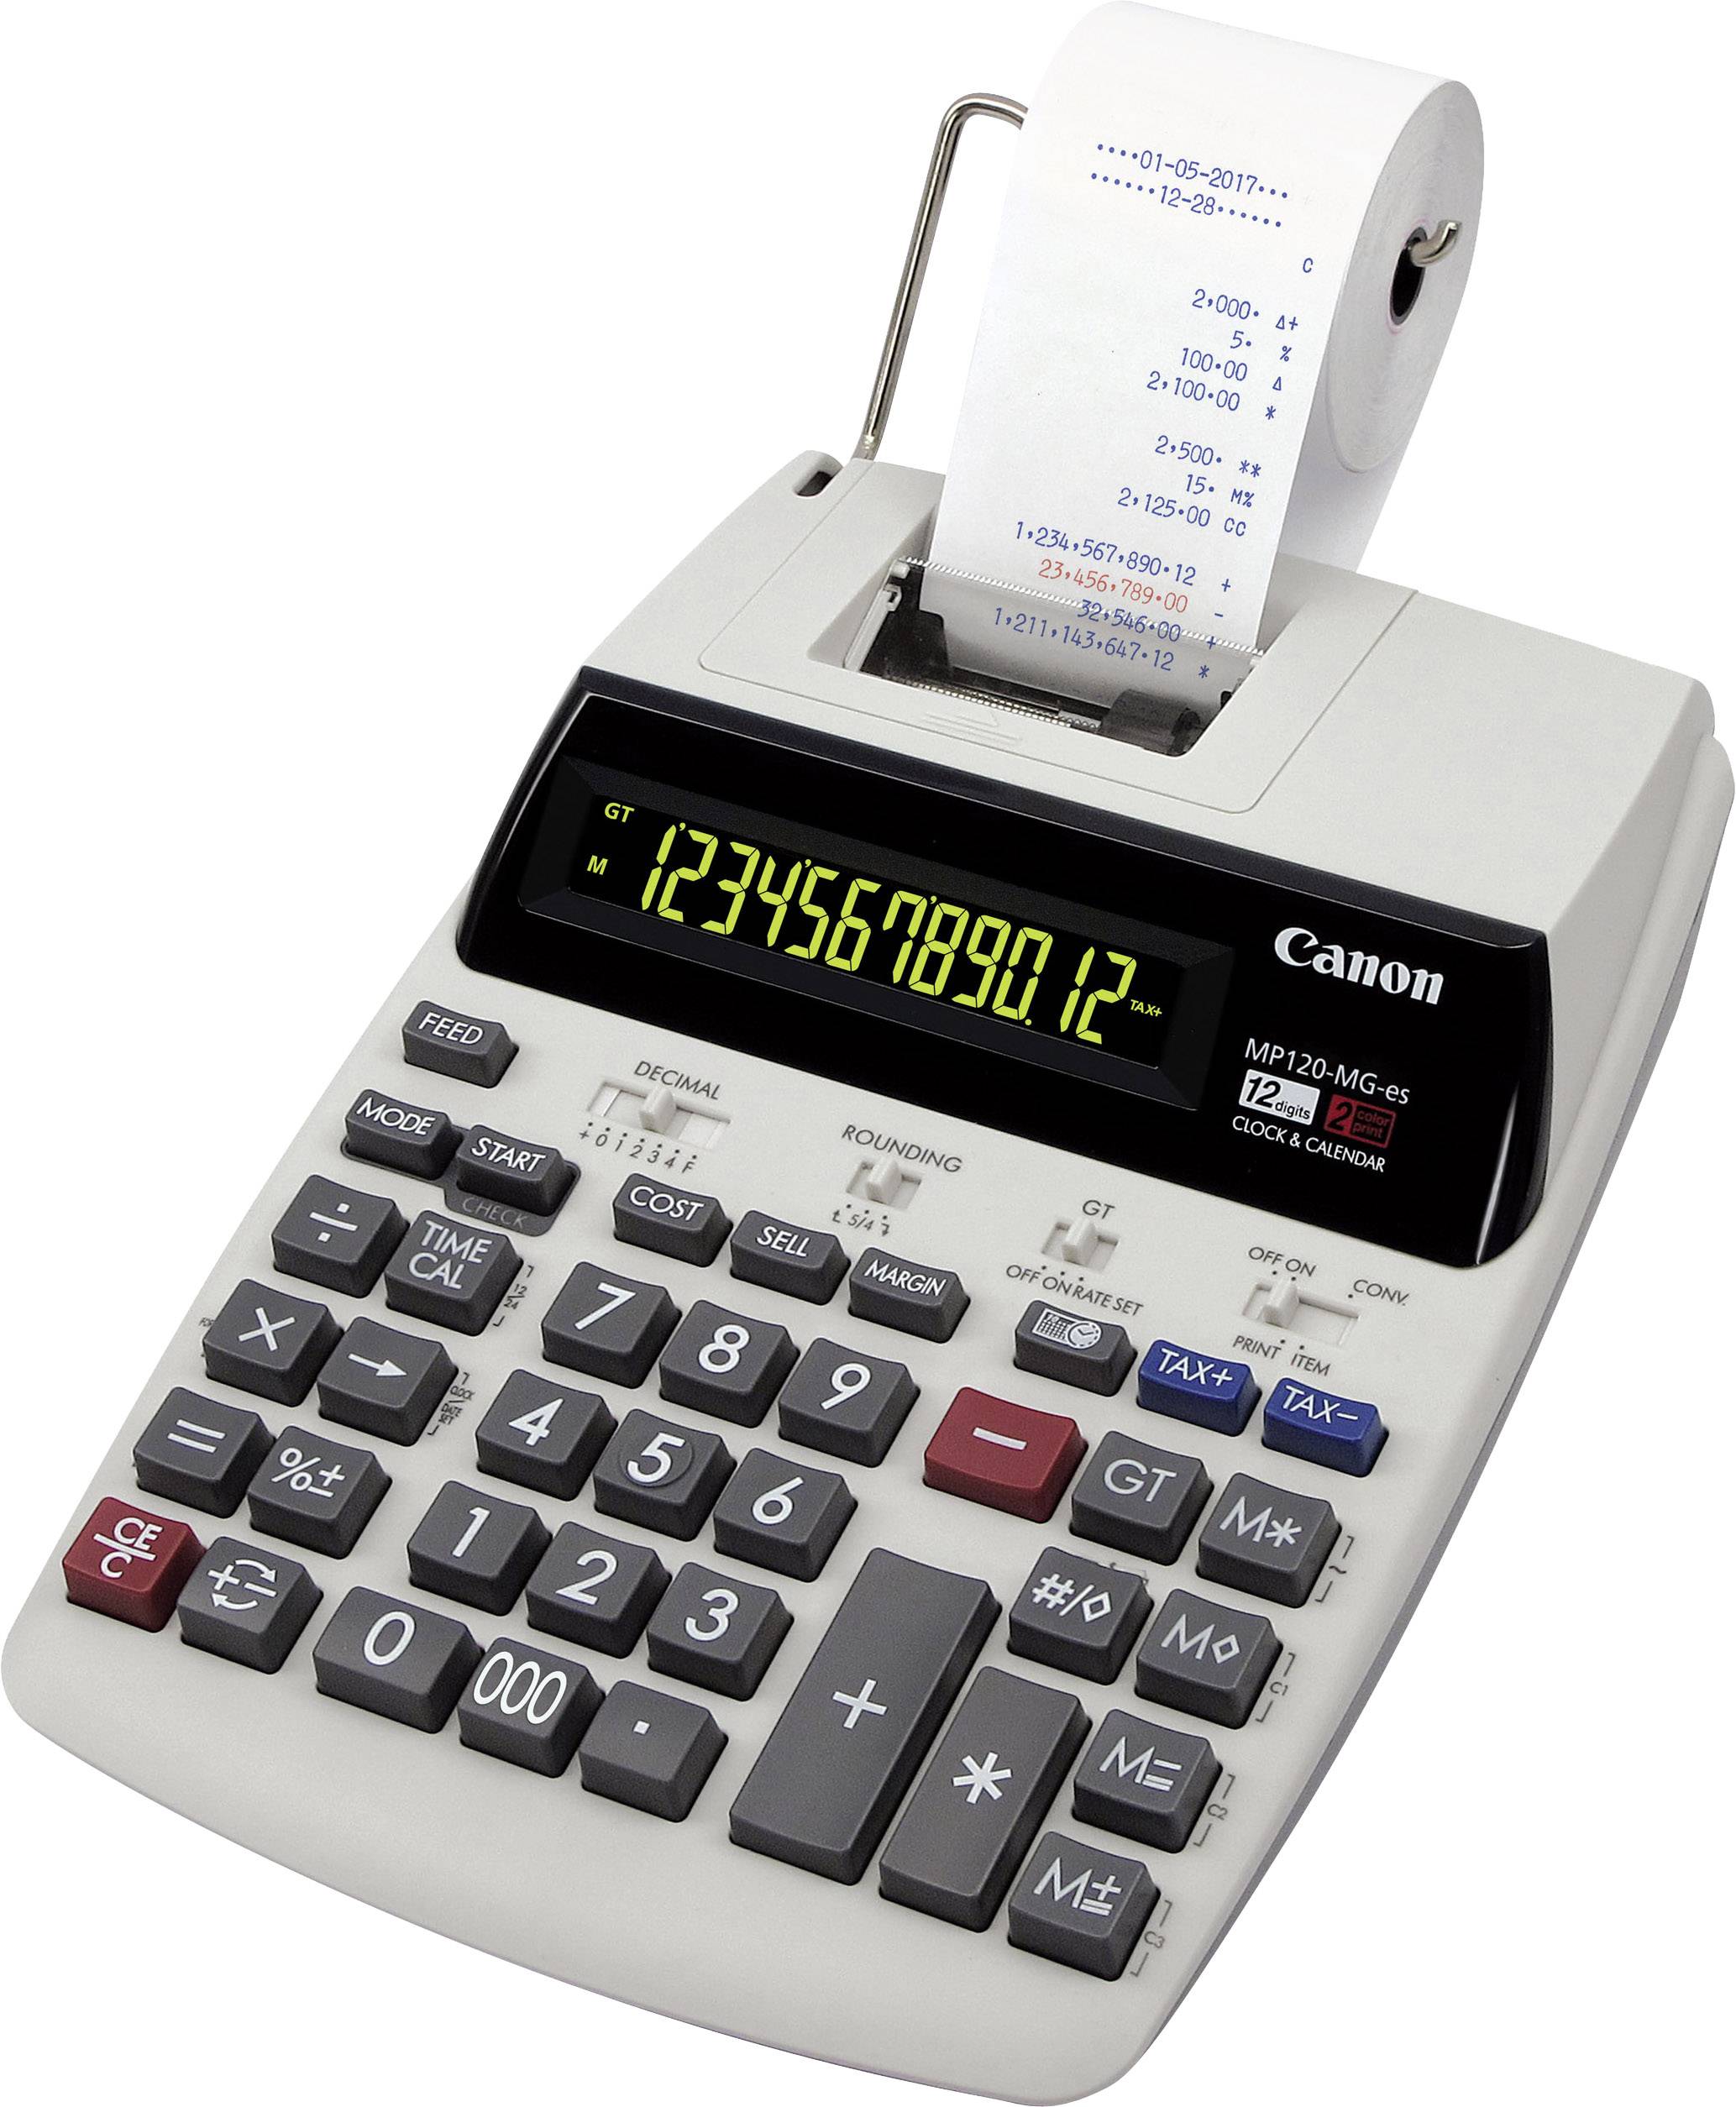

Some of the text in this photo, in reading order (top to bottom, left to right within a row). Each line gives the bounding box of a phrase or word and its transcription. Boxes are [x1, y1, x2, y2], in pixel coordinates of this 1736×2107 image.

[1302, 258, 1314, 273] C
[1224, 516, 1247, 537] CC
[604, 802, 634, 824] GT
[586, 855, 608, 876] M
[1274, 927, 1444, 1004] Canon
[418, 1012, 483, 1045] FEED
[634, 1060, 721, 1100] DECIMAL
[1245, 1038, 1410, 1104] MP120-MG-es
[356, 1097, 435, 1135] MODE
[1246, 1077, 1311, 1119] 12 digits
[1328, 1102, 1390, 1130] 2 color
[842, 1125, 963, 1173] ROUNDING
[1233, 1115, 1386, 1172] CLOCK & CALENDAR
[1352, 1121, 1384, 1140] print
[471, 1137, 546, 1172] START
[463, 1198, 527, 1228] CHECK
[630, 1185, 704, 1223] COST
[1082, 1199, 1115, 1220] GT
[421, 1219, 492, 1264] TIME
[757, 1225, 810, 1258] SELL
[1249, 1246, 1317, 1277] OFF ON
[408, 1253, 463, 1290] CAL
[864, 1261, 946, 1297] MARGIN
[1006, 1264, 1144, 1317] OFF ON RATE SET
[574, 1281, 636, 1331] 7
[697, 1324, 750, 1374] 8
[1158, 1347, 1233, 1388] TAX+
[1233, 1335, 1330, 1376] PRINT ITEM
[821, 1363, 870, 1411] 9
[507, 1398, 564, 1446] 4
[627, 1432, 685, 1484] 5
[1104, 1458, 1176, 1503] GT
[753, 1476, 805, 1526] 6
[113, 1517, 163, 1550] CE
[453, 1506, 490, 1558] 1
[100, 1551, 133, 1579] C
[555, 1550, 616, 1605] 2
[684, 1589, 738, 1642] 3
[364, 1612, 415, 1666] 0
[474, 1651, 567, 1725] 000
[1269, 1680, 1289, 1696] C1
[1207, 1802, 1228, 1821] C2
[1144, 1931, 1166, 1949] C3
